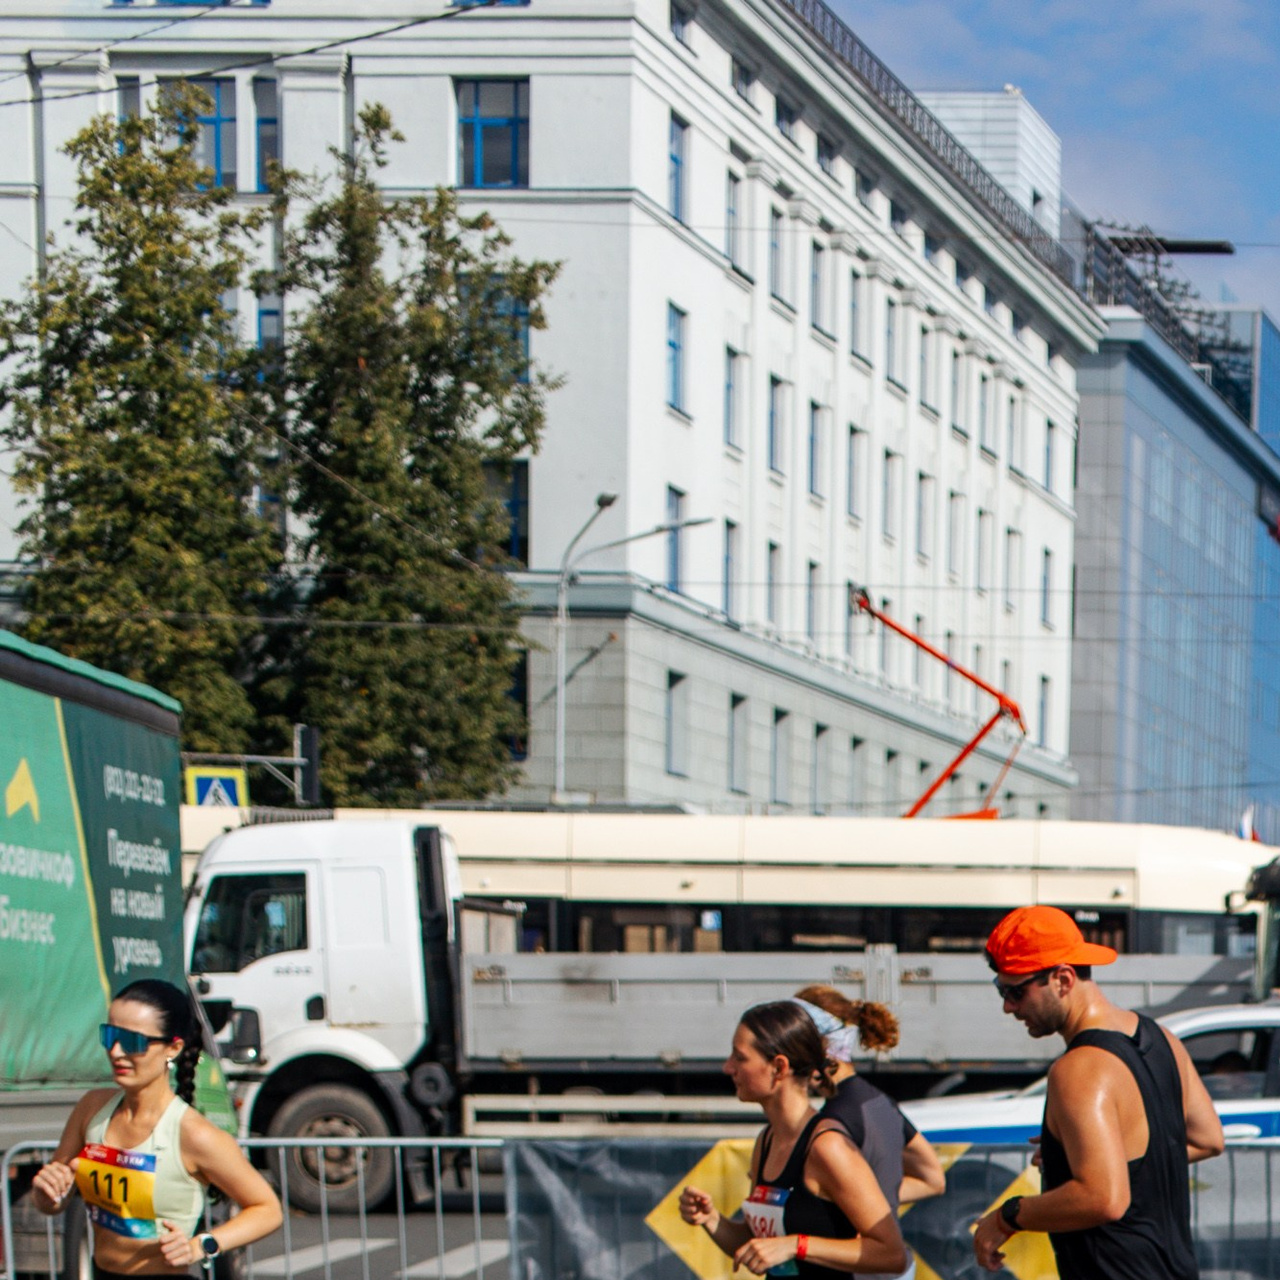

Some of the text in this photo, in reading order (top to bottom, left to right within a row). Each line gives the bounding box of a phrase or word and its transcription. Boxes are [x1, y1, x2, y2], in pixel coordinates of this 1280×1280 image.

[107, 828, 171, 878] Перевезём
[111, 883, 165, 921] на новый
[112, 936, 162, 974] уровень
[89, 1169, 128, 1203] 111
